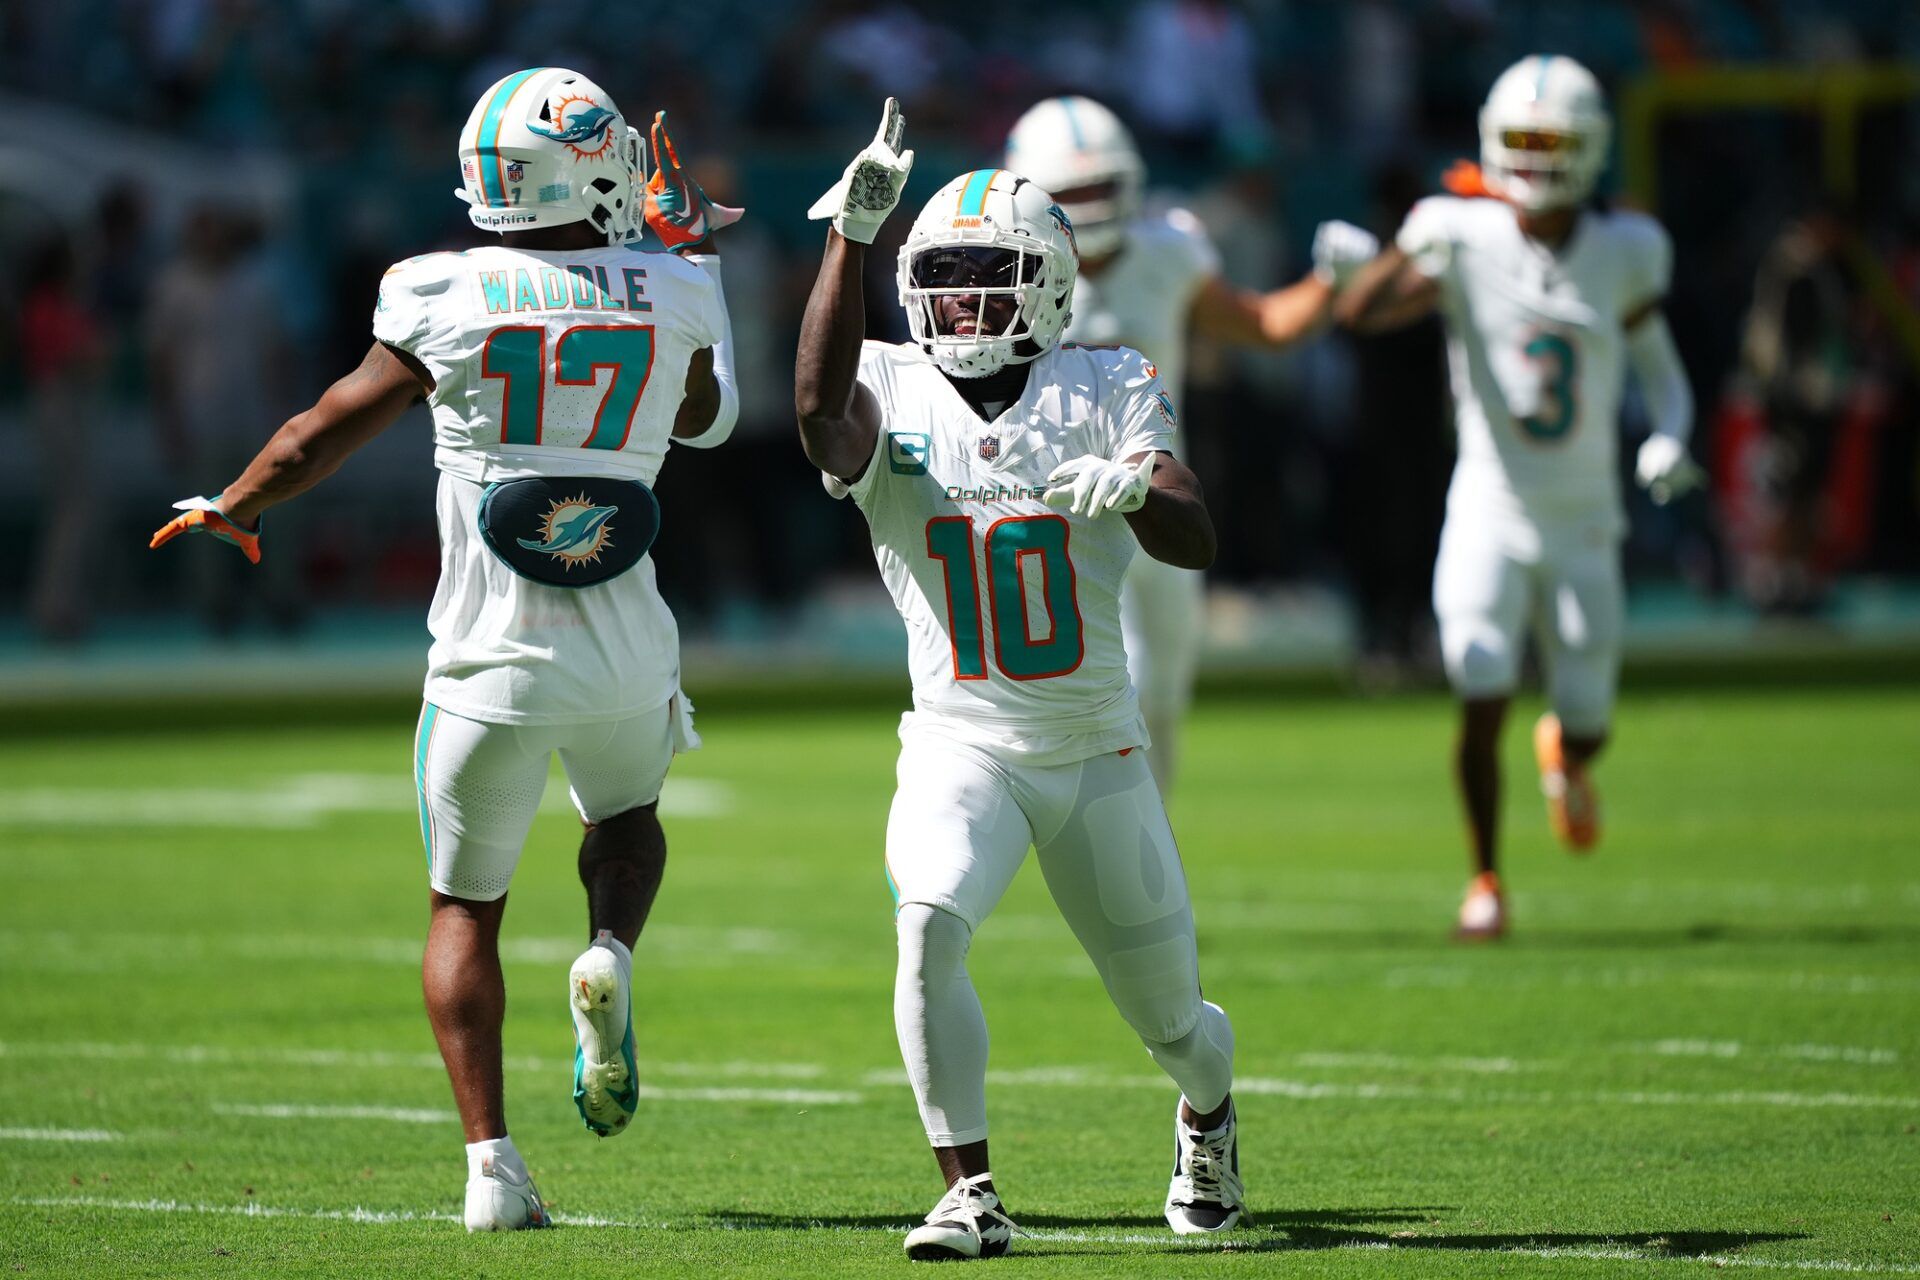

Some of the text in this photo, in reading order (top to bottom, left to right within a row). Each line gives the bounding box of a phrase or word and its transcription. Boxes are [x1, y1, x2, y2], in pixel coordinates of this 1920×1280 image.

[511, 187, 522, 205] 7
[475, 214, 537, 227] Dolphins
[479, 265, 653, 314] WADDLE
[481, 324, 655, 451] 17
[1517, 325, 1583, 449] 3
[891, 434, 926, 465] C
[944, 484, 1048, 507] Dolphins
[925, 514, 1085, 681] 10
